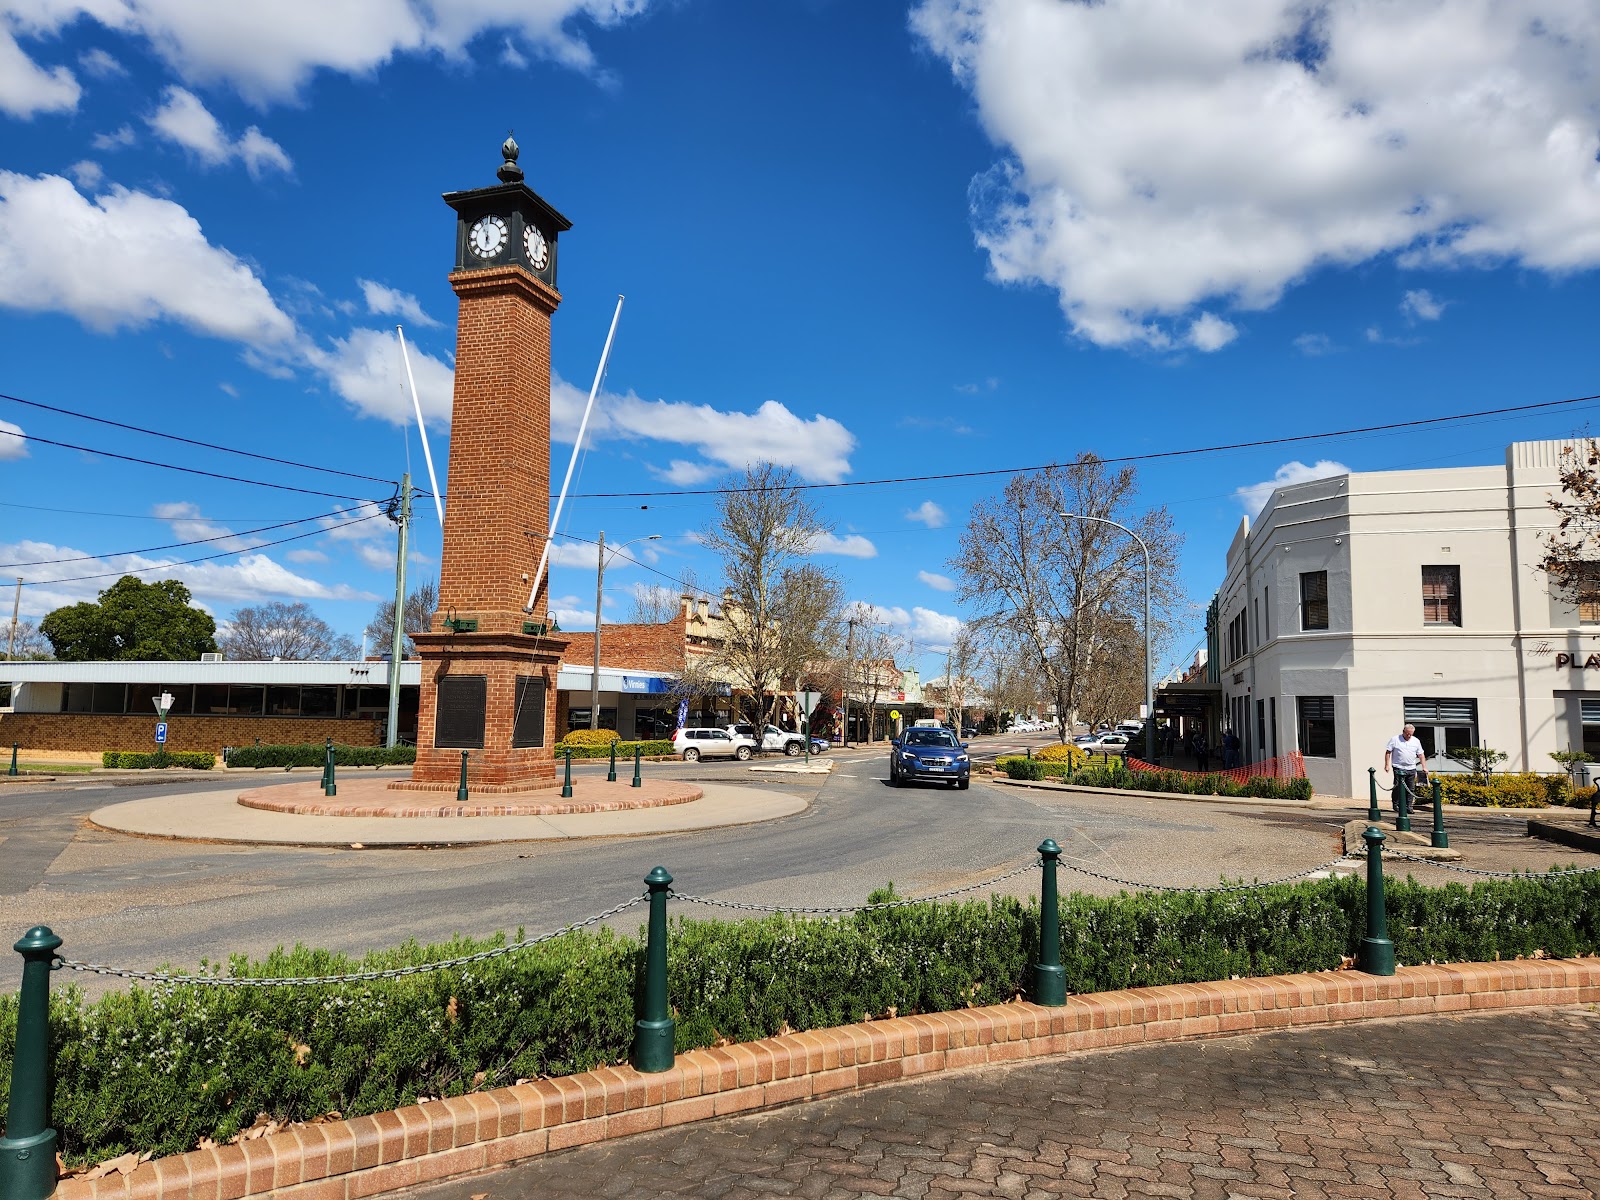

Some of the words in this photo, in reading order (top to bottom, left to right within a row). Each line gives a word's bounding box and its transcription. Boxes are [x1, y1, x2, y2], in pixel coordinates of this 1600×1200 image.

[1527, 640, 1555, 657] The
[1557, 653, 1600, 668] PLA
[628, 680, 645, 689] Vinnies
[158, 725, 165, 735] P
